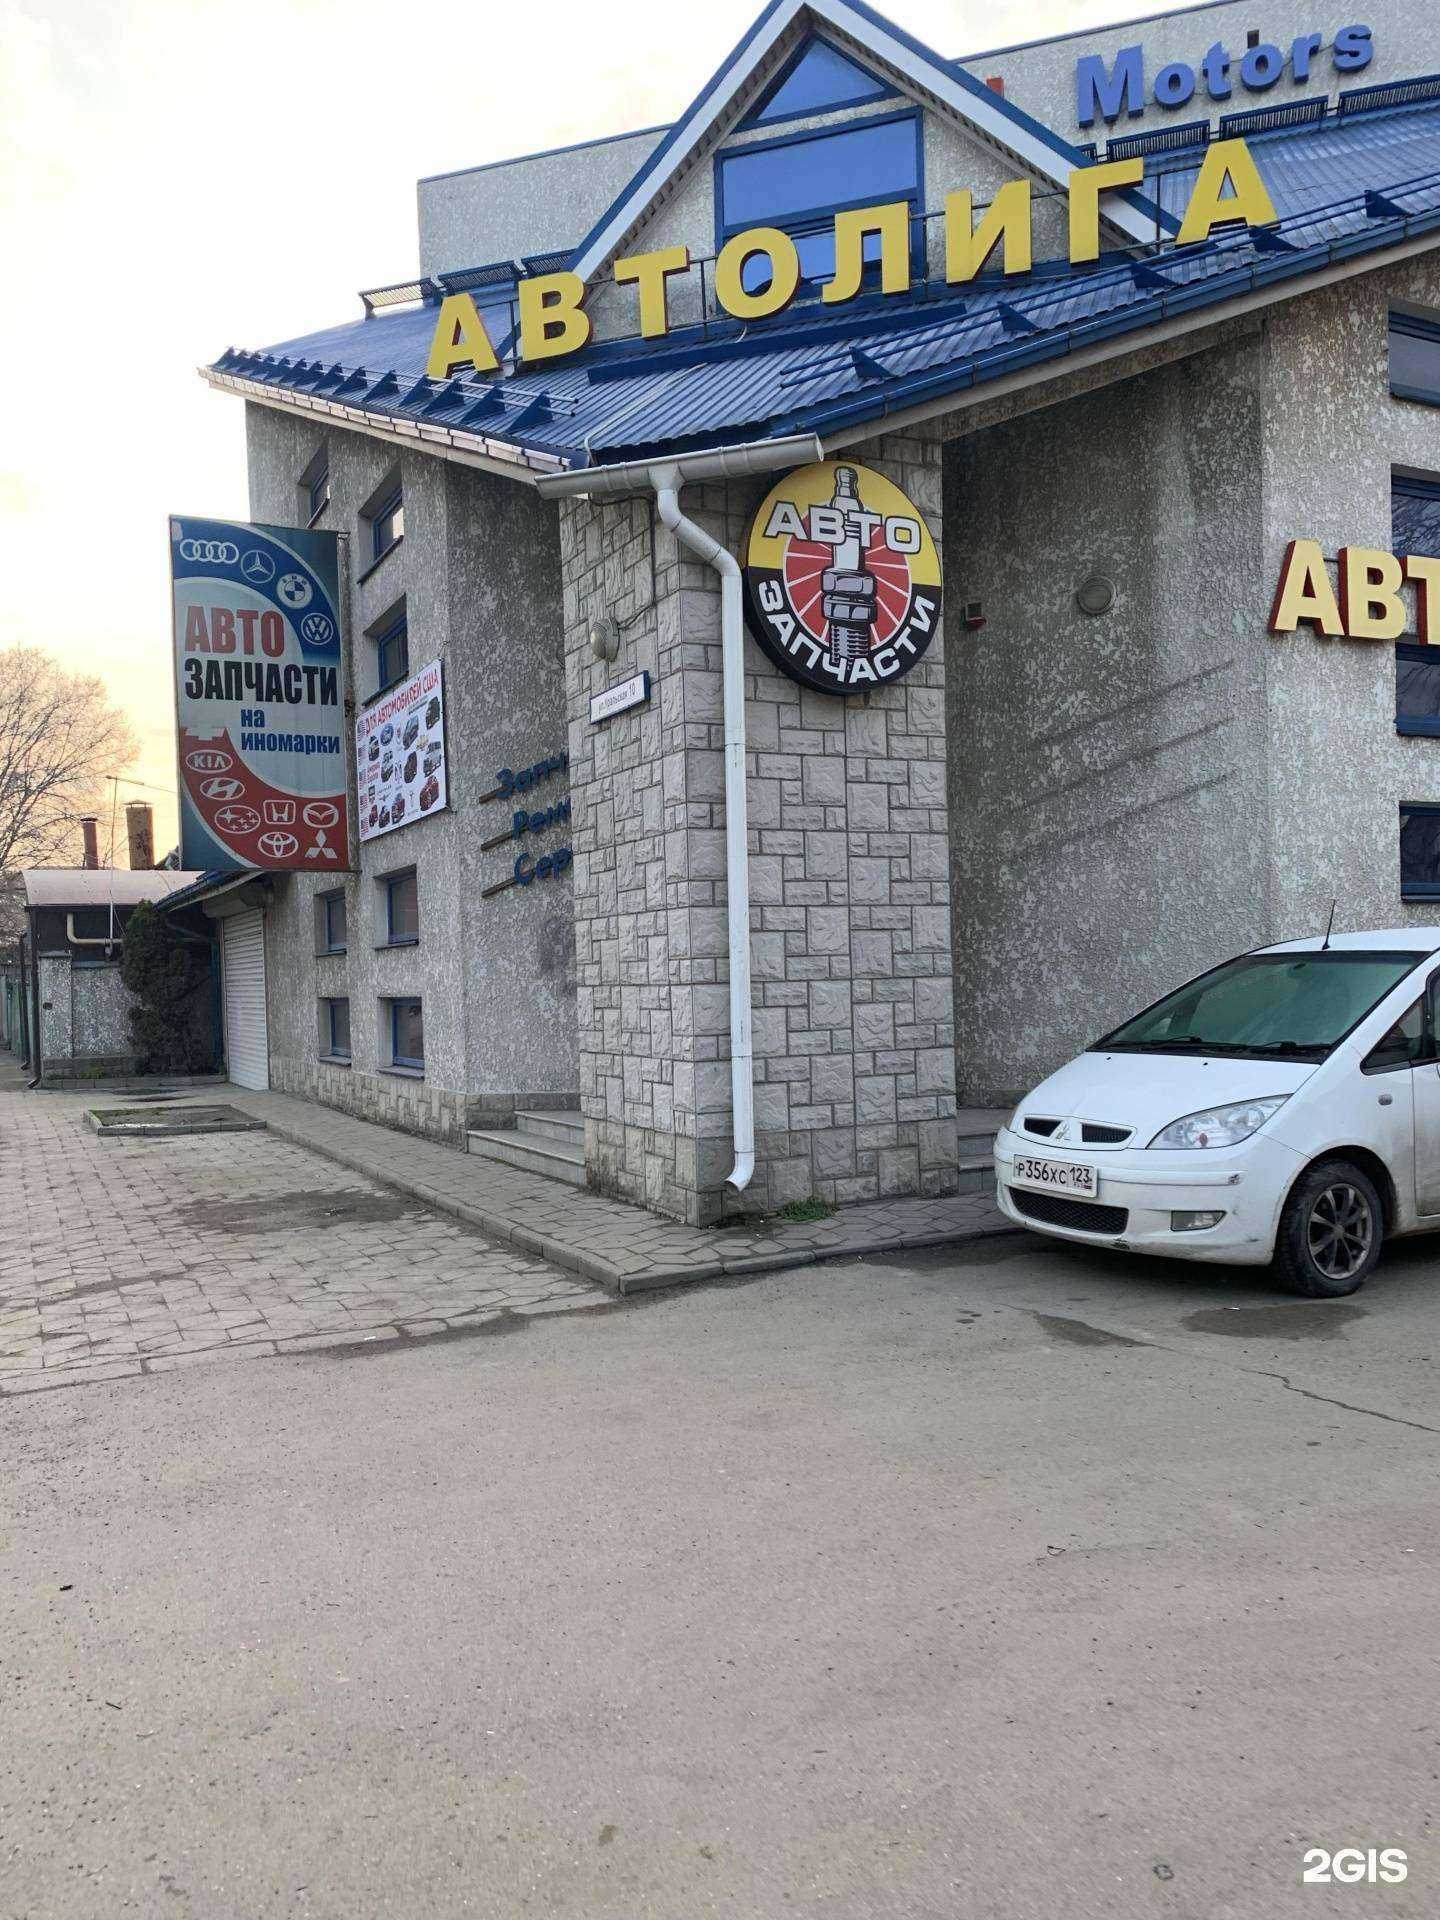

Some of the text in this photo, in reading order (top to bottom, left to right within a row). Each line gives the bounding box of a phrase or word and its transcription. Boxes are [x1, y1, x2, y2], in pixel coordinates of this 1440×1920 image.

[1076, 23, 1374, 128] Motors
[426, 137, 1280, 380] АВТОЛИГА
[762, 500, 921, 555] АВТО
[184, 605, 286, 658] АВТО
[758, 579, 936, 684] ЗАПЧАСТИ
[184, 657, 339, 706] ЗАПЧАСТИ
[240, 708, 266, 728] на
[240, 733, 341, 755] иномарки
[193, 754, 226, 769] KIA
